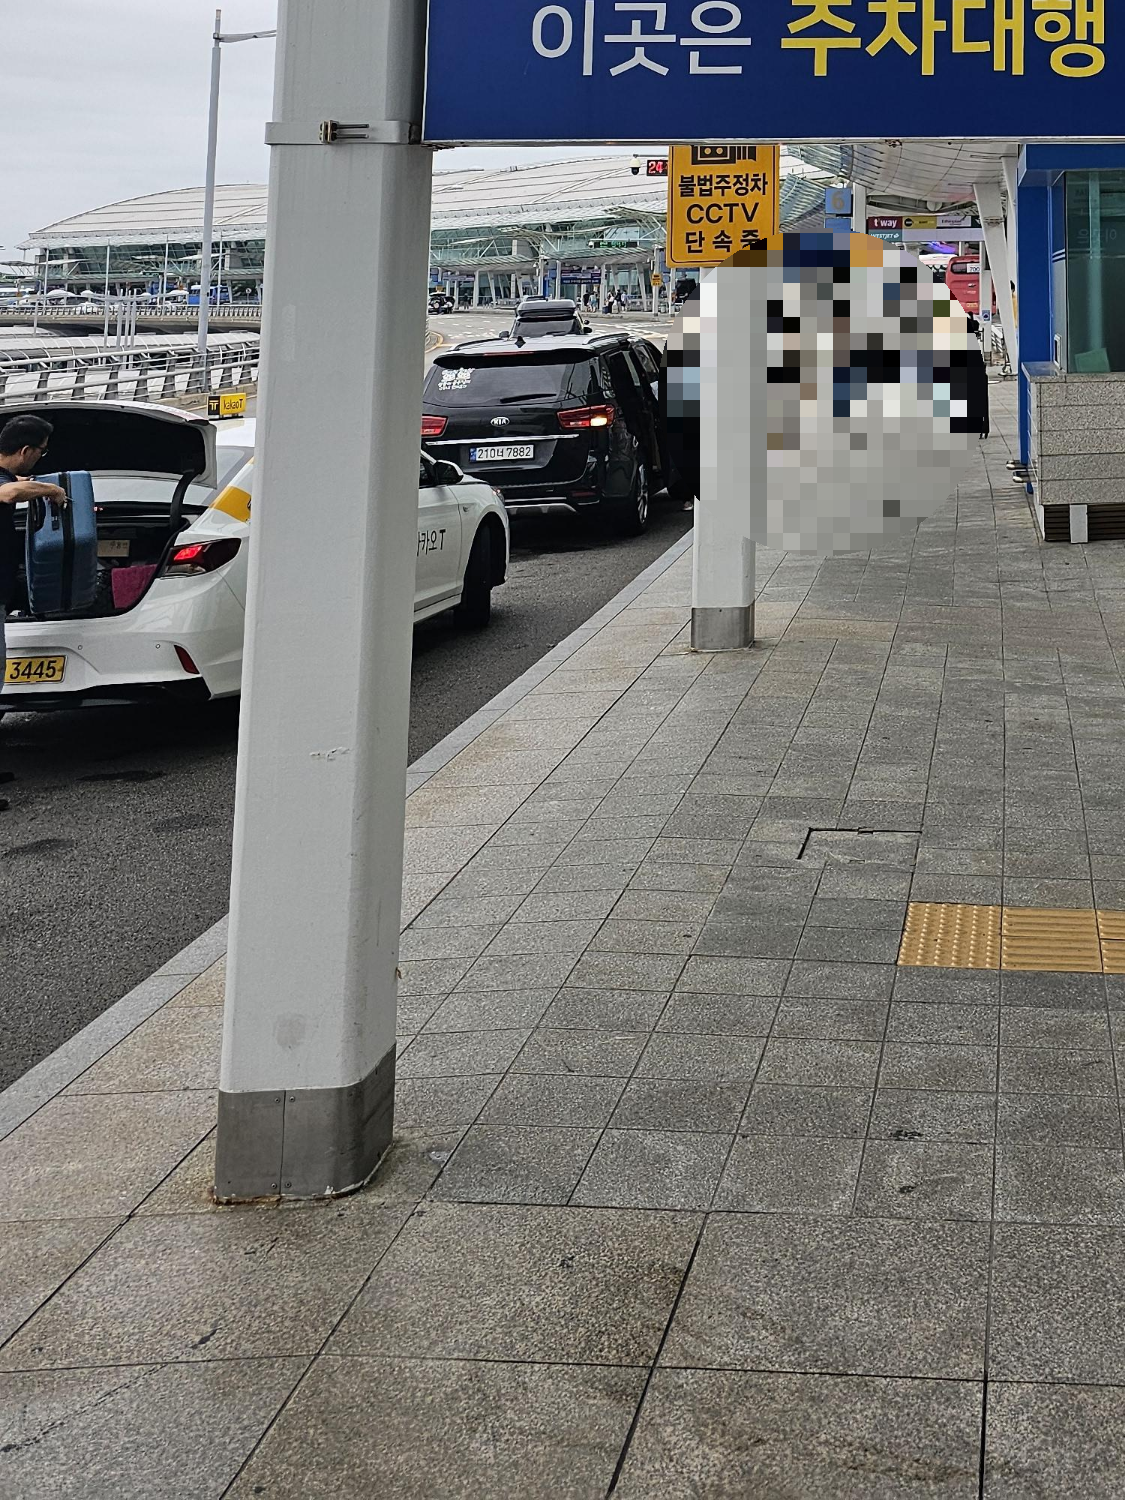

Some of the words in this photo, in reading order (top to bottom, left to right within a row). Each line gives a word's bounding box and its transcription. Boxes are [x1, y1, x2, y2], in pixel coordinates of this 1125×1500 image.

[531, 0, 752, 77] 이곳은
[678, 172, 769, 198] 불법주정차
[831, 190, 845, 212] 6
[686, 201, 760, 224] CCTV
[506, 446, 531, 458] 7882
[10, 660, 57, 680] 3445
